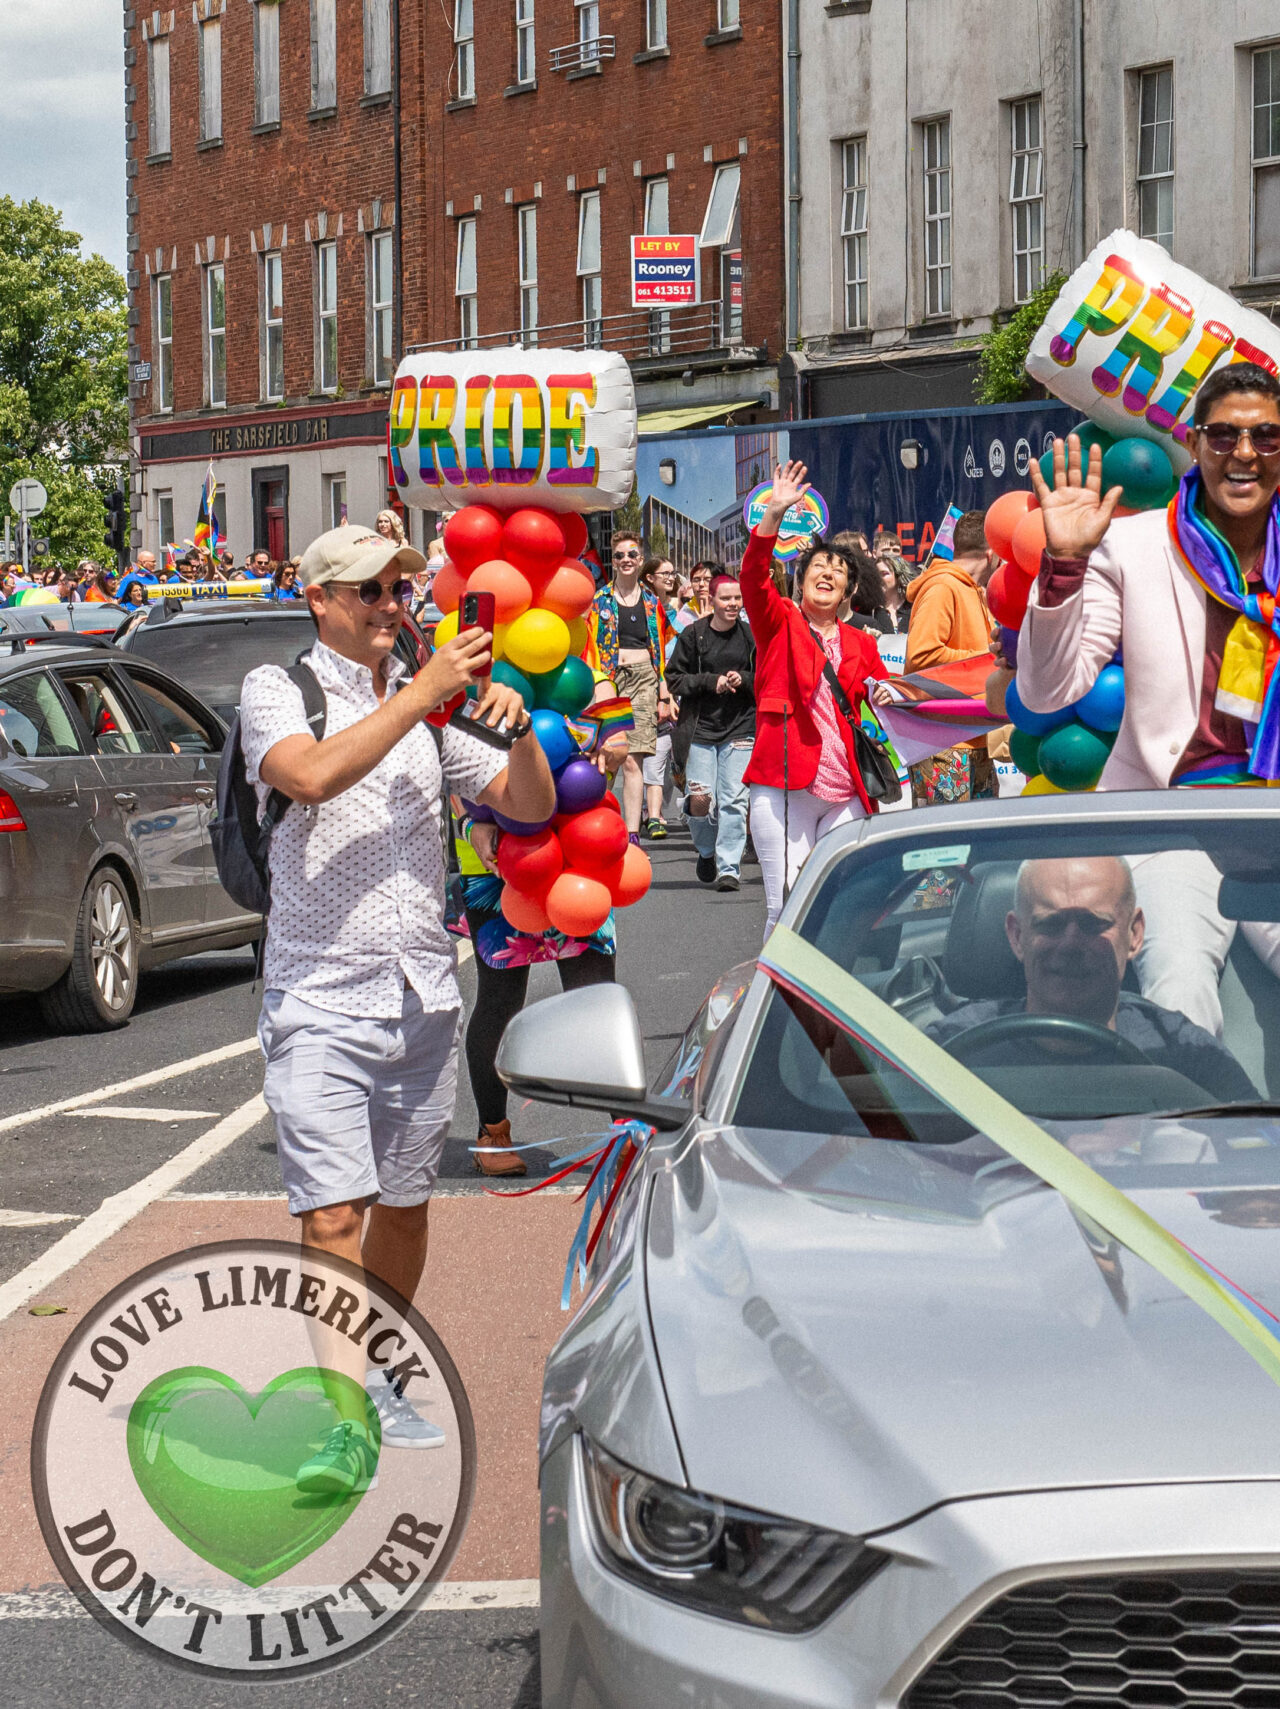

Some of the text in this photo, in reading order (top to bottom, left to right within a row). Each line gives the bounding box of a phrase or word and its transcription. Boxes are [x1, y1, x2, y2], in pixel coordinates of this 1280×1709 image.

[640, 241, 680, 251] LET BY
[638, 263, 692, 277] Rooney
[637, 285, 692, 296] 061 413511
[211, 418, 328, 451] THE SARSFIELD BAR
[390, 372, 600, 488] PRIDE
[195, 582, 226, 595] TAXI
